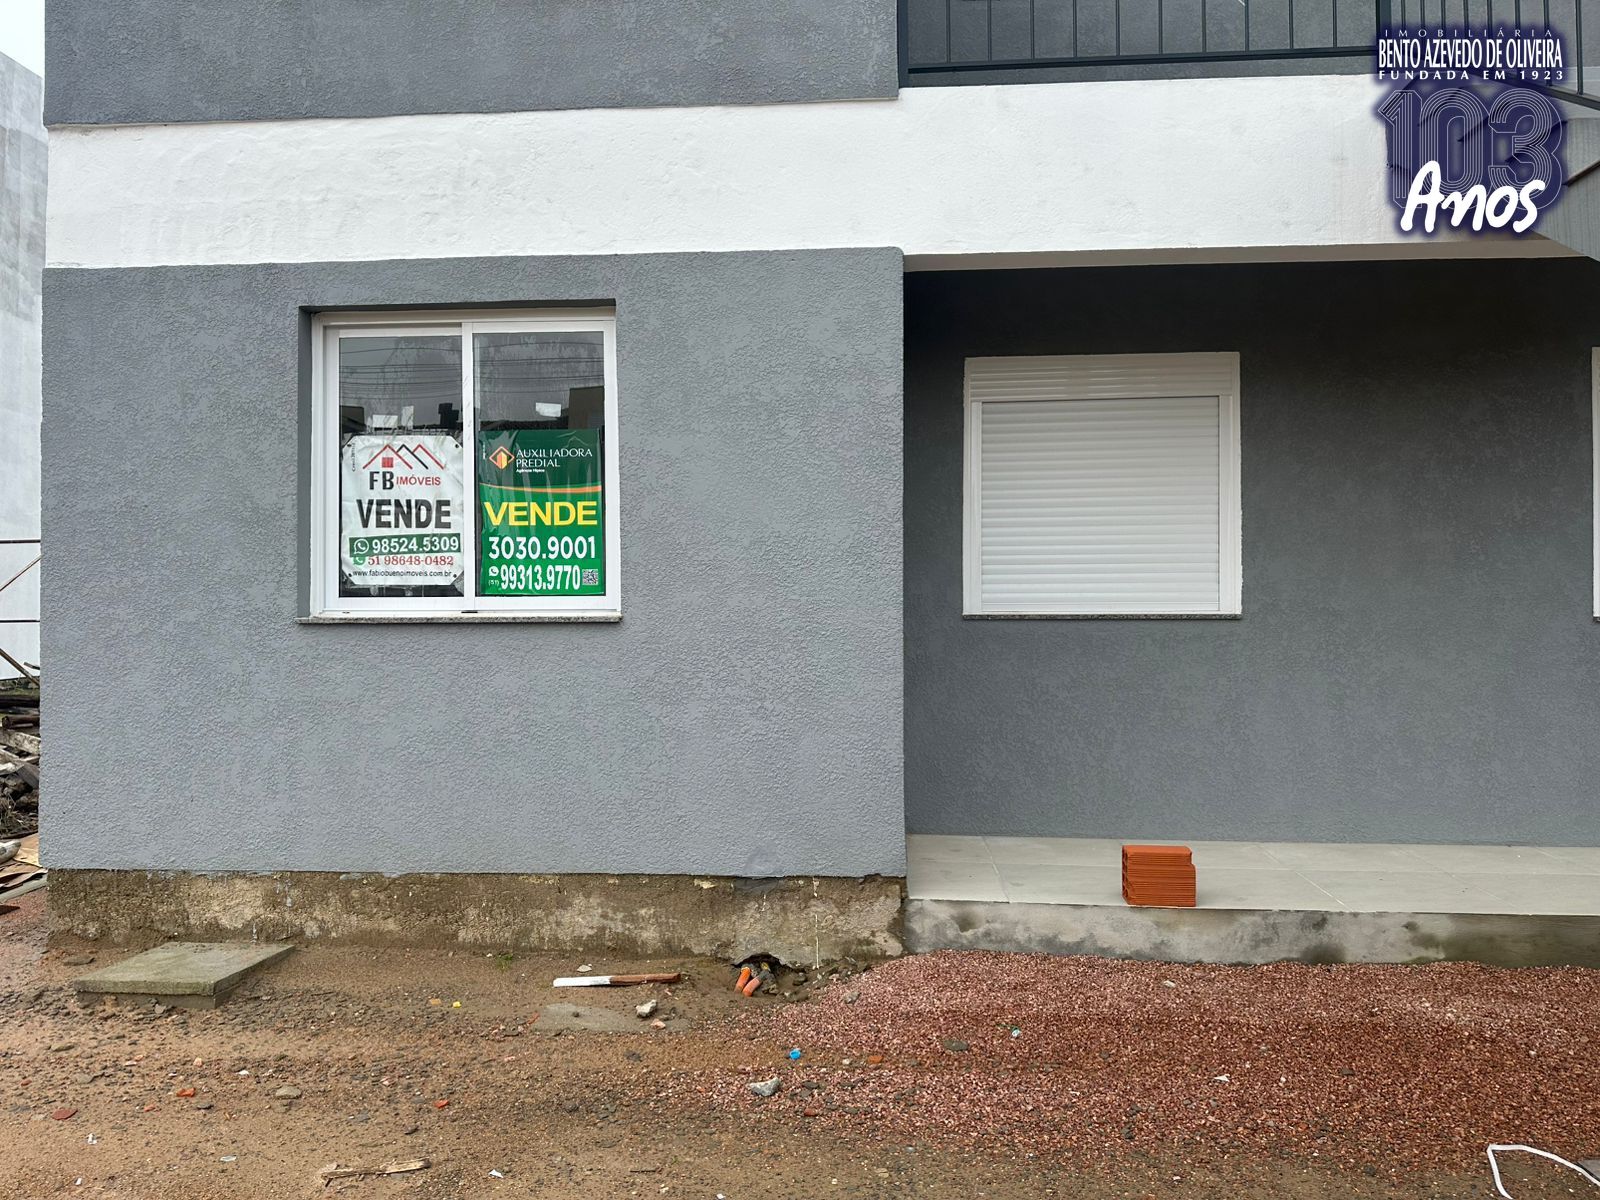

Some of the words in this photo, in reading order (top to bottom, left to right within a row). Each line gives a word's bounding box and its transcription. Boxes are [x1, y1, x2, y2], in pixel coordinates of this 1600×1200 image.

[516, 448, 593, 458] AUXILIADORA
[516, 459, 560, 468] PREDIAL
[369, 471, 394, 490] FB
[396, 474, 441, 486] IMÓVEIS
[356, 499, 452, 529] VENDE
[484, 501, 598, 526] VENDE
[372, 536, 459, 553] 98524.5309
[488, 536, 596, 560] 3030.9001
[384, 555, 454, 566] 98648-0482
[500, 564, 581, 590] 99313.9770
